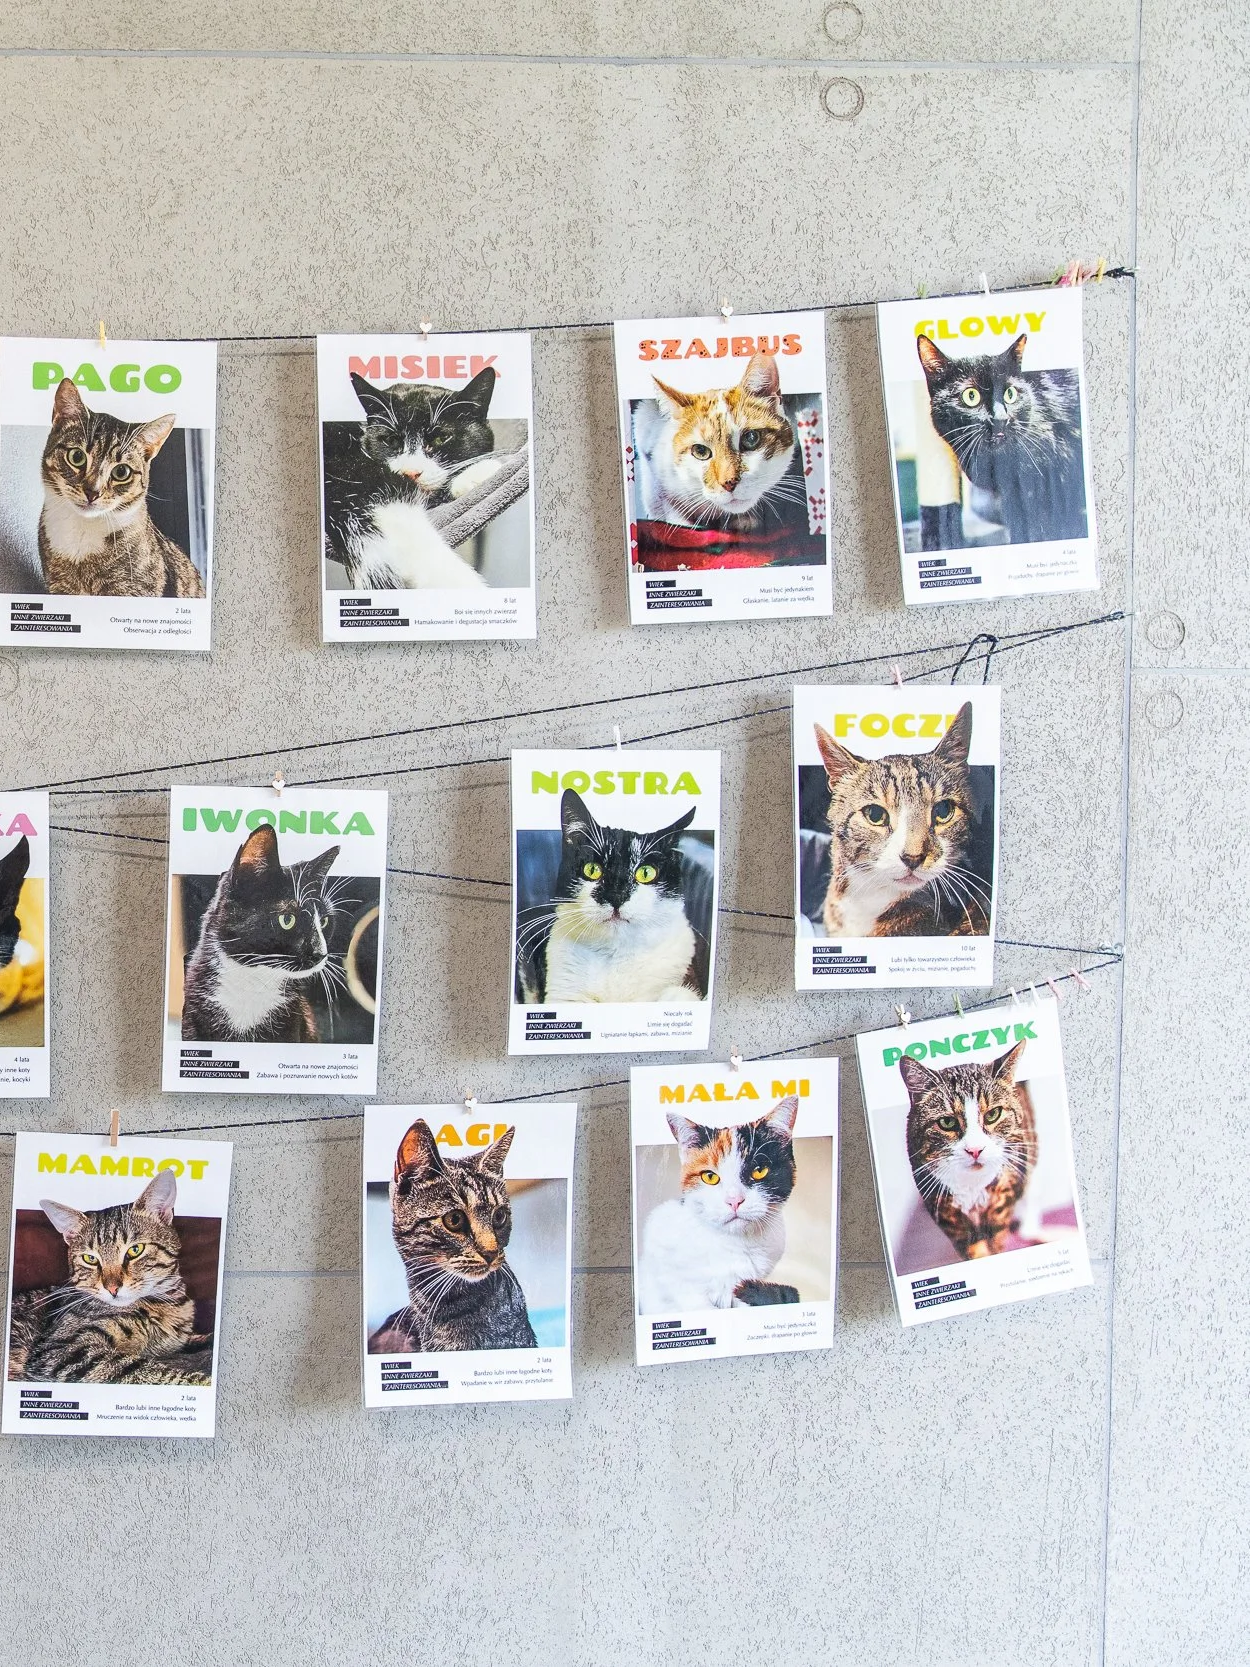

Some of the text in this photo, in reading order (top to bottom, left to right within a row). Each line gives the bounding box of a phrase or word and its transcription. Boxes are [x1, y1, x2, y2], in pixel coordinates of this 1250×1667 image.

[914, 311, 1047, 341] GLOWY
[638, 333, 803, 362] SZAJBUS
[32, 361, 182, 394] PAGO
[348, 355, 501, 379] MISIEK
[531, 770, 702, 796] NOSTRA
[182, 807, 376, 837] IWONKA
[882, 1020, 1038, 1067] PONCZYK
[771, 1079, 810, 1098] MI
[37, 1152, 209, 1180] MAMROT
